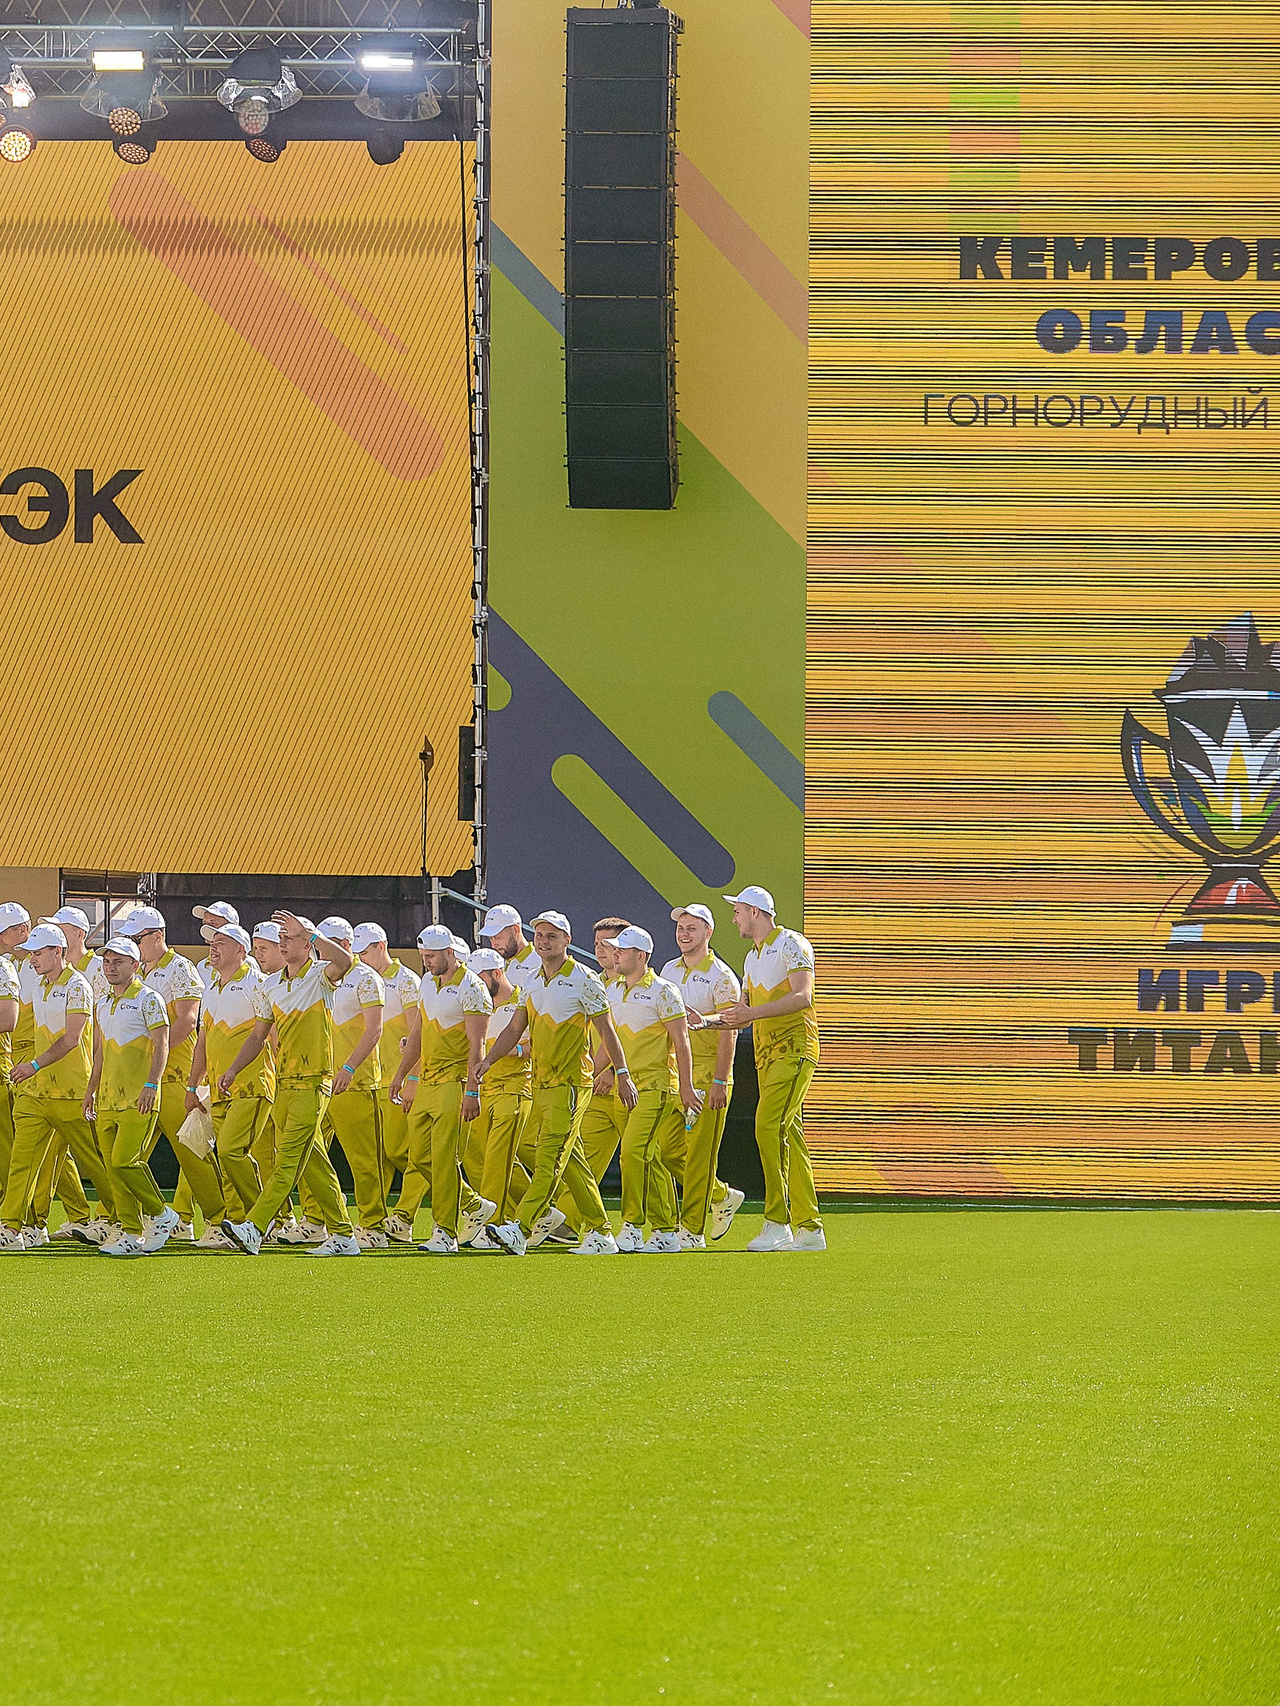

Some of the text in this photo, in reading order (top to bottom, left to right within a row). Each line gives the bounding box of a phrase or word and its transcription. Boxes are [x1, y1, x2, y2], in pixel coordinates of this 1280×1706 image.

[1036, 309, 1280, 355] ОБЛАС
[924, 387, 1268, 435] ГОРНОРУДНЫЙ
[1138, 968, 1280, 1013] ИГР
